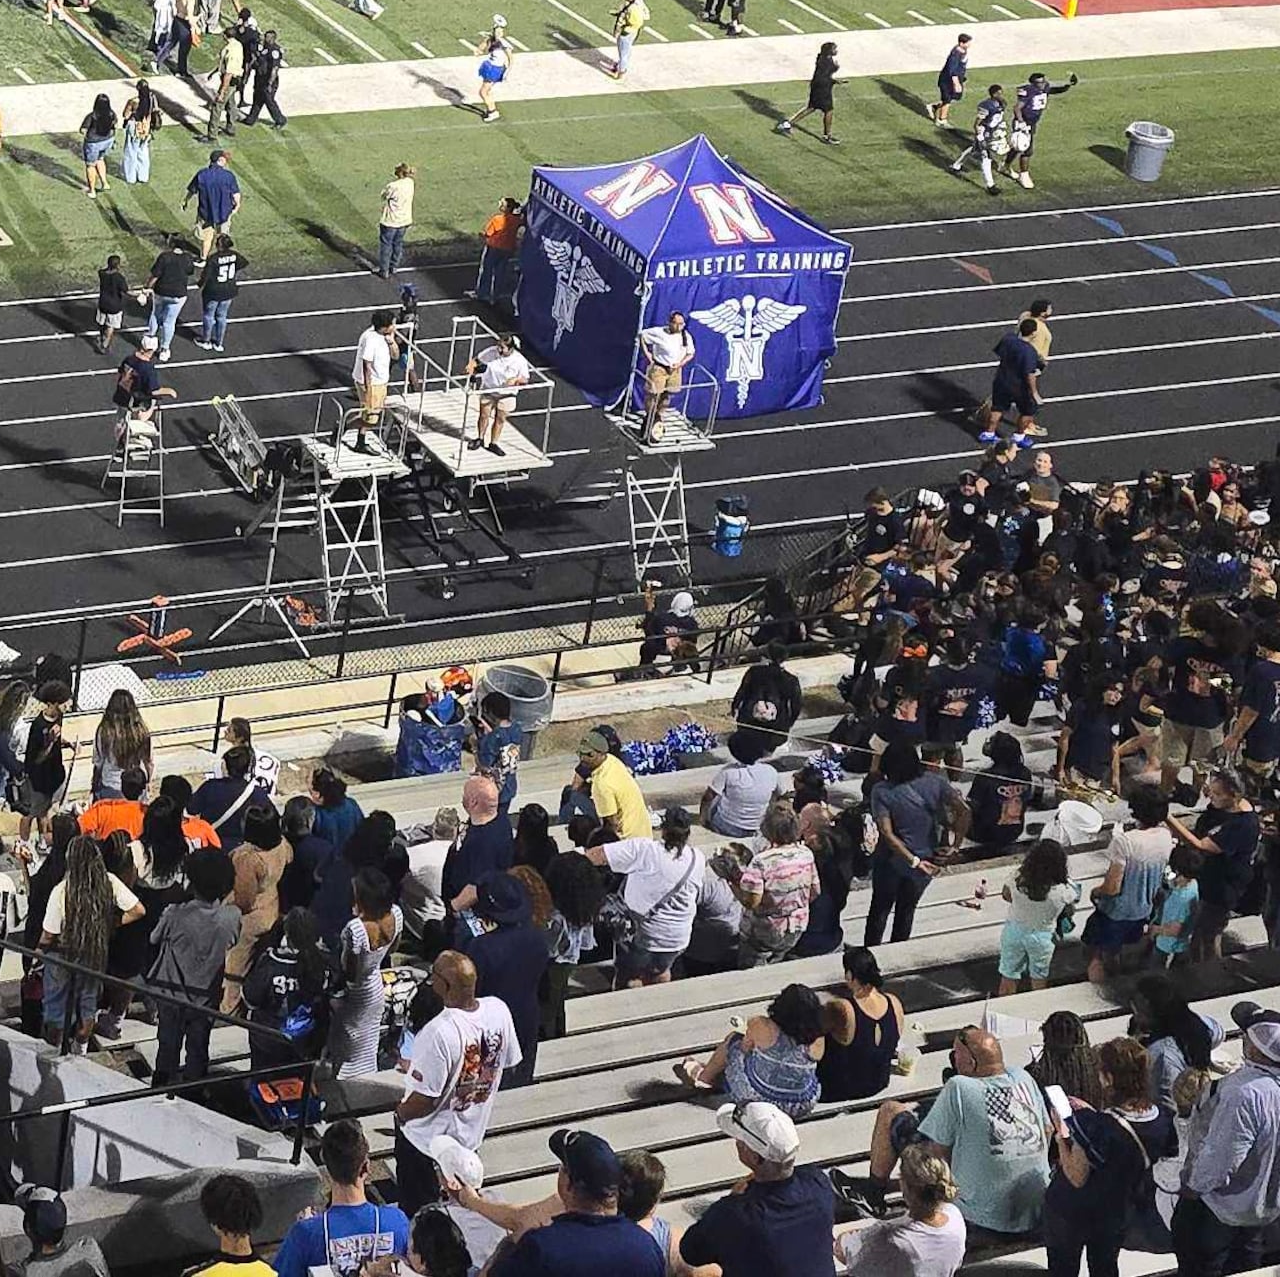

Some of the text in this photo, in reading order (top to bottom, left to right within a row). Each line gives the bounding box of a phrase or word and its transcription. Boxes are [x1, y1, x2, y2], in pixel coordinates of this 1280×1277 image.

[584, 163, 678, 221] N
[689, 182, 776, 245] N
[532, 176, 646, 274] ATHLETIC TRAINING
[654, 250, 846, 280] ATHLETIC TRAINING
[725, 337, 764, 383] N
